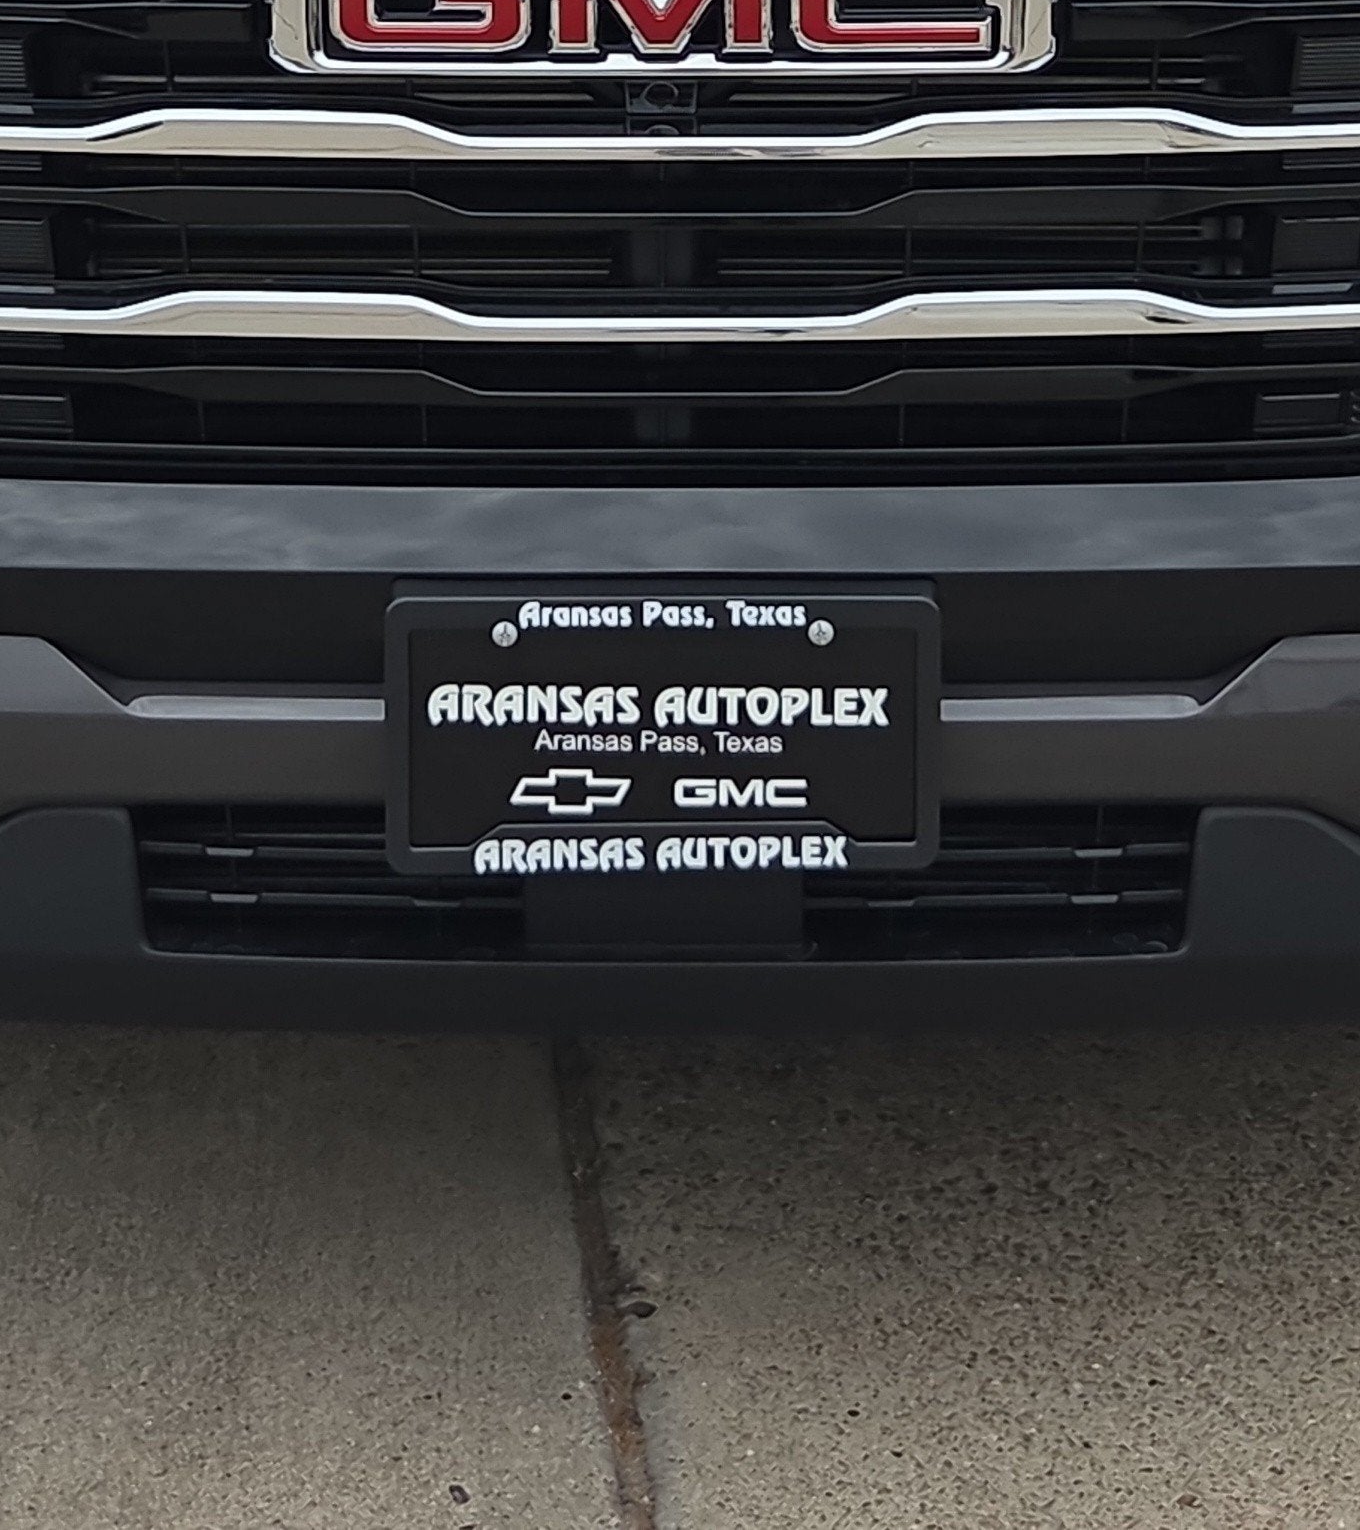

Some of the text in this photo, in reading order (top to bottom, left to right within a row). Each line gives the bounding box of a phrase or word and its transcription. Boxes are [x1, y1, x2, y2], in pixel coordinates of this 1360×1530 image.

[517, 600, 808, 629] Aransas Pass, Texas
[427, 684, 890, 728] ARANSAS AUTOPLEX
[534, 729, 784, 756] Aransas Pass, Texas
[673, 778, 808, 808] GMC
[474, 835, 848, 874] ARANSAS AUTOPLEX
